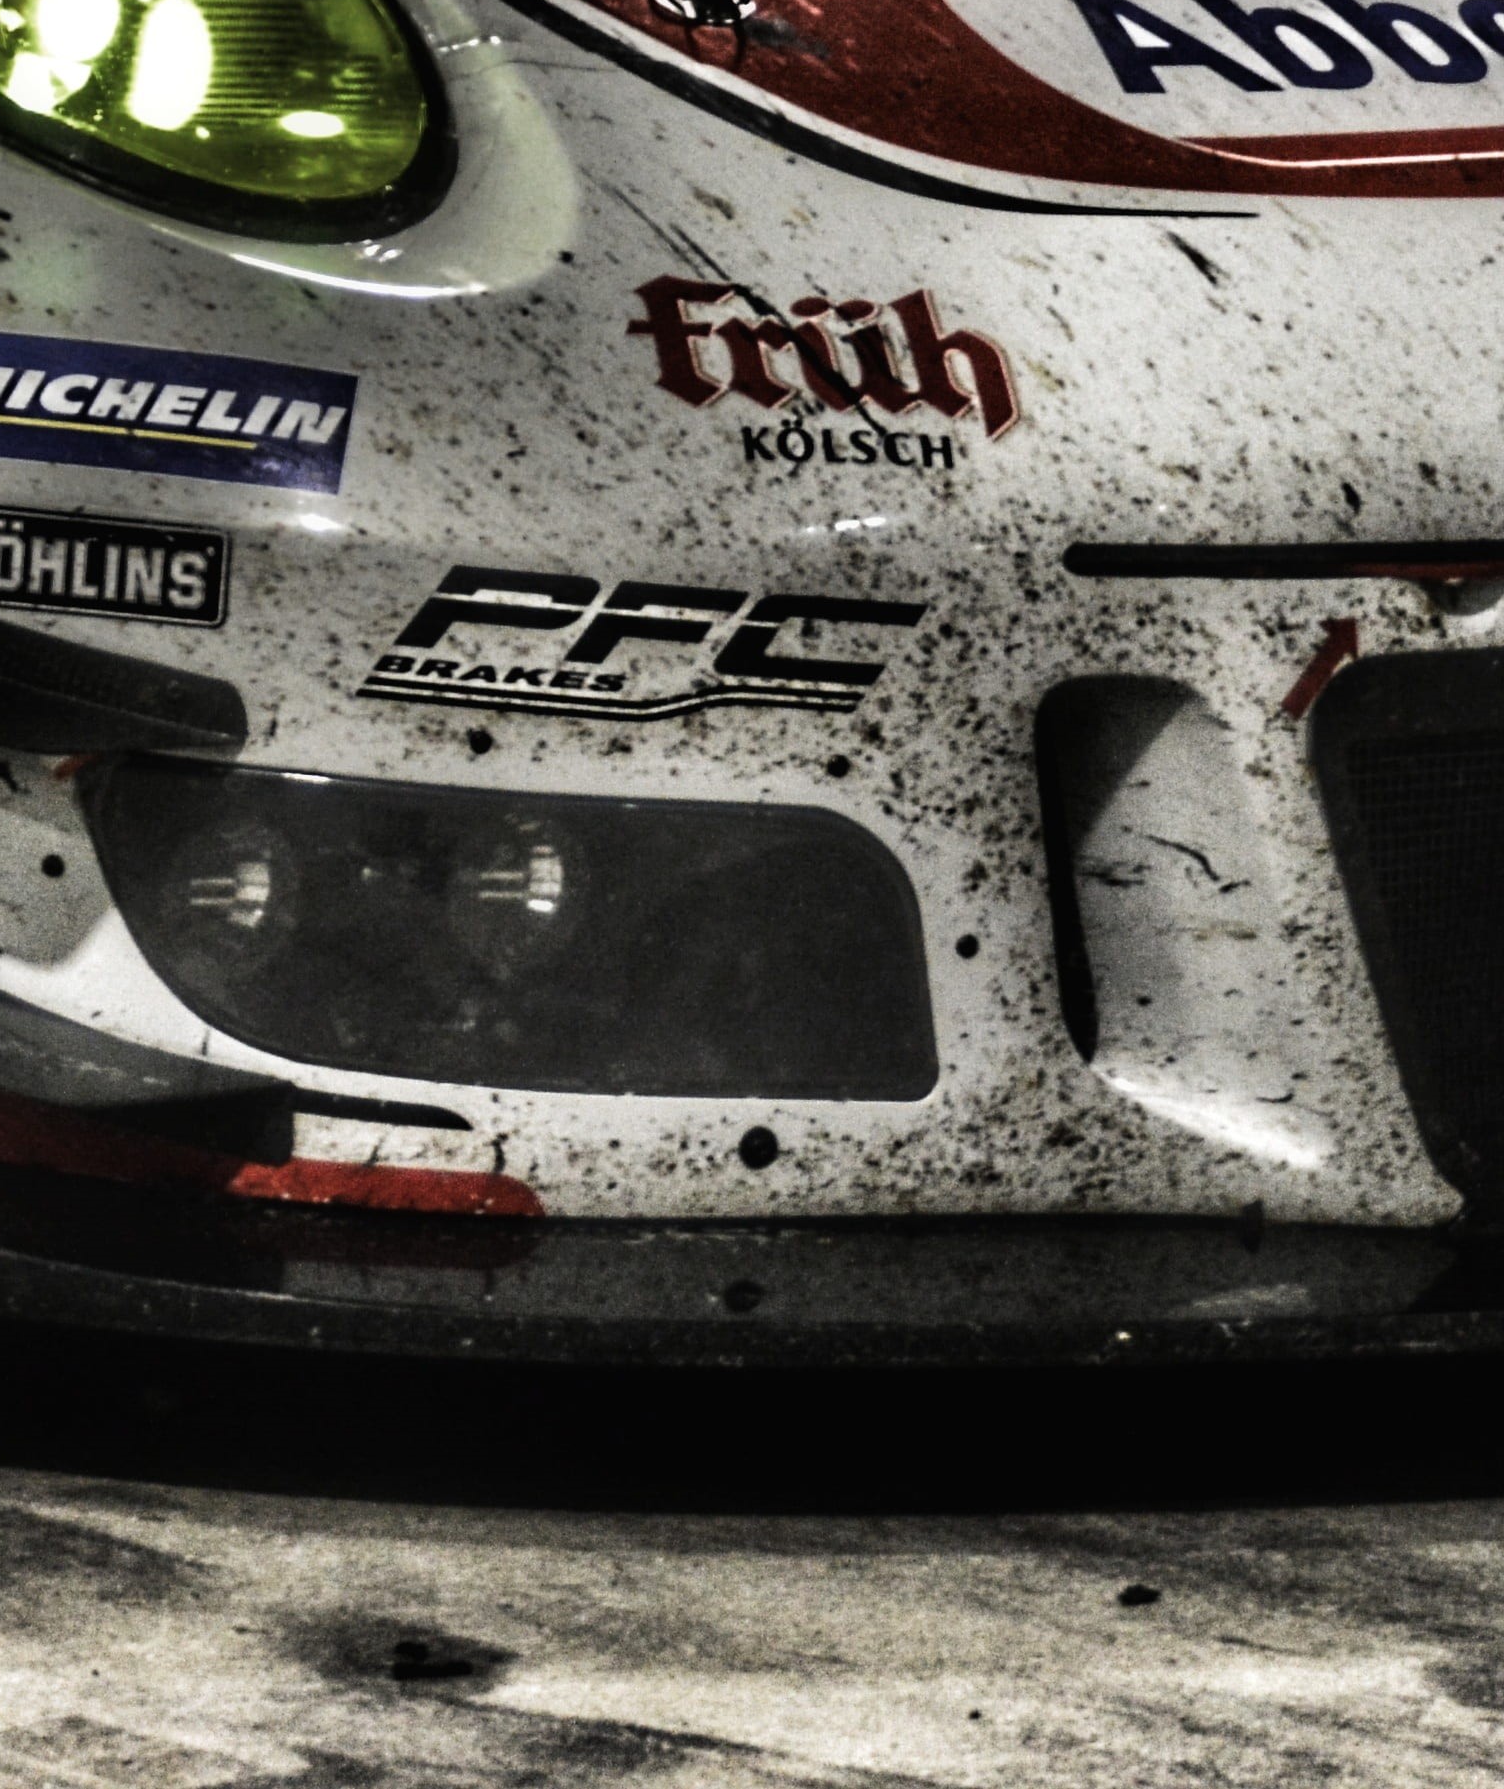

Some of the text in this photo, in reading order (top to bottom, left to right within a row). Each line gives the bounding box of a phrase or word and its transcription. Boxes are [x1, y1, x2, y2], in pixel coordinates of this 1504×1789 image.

[741, 418, 955, 470] KÖLSCH
[393, 563, 930, 685] PFC
[372, 653, 626, 694] BRAKES
